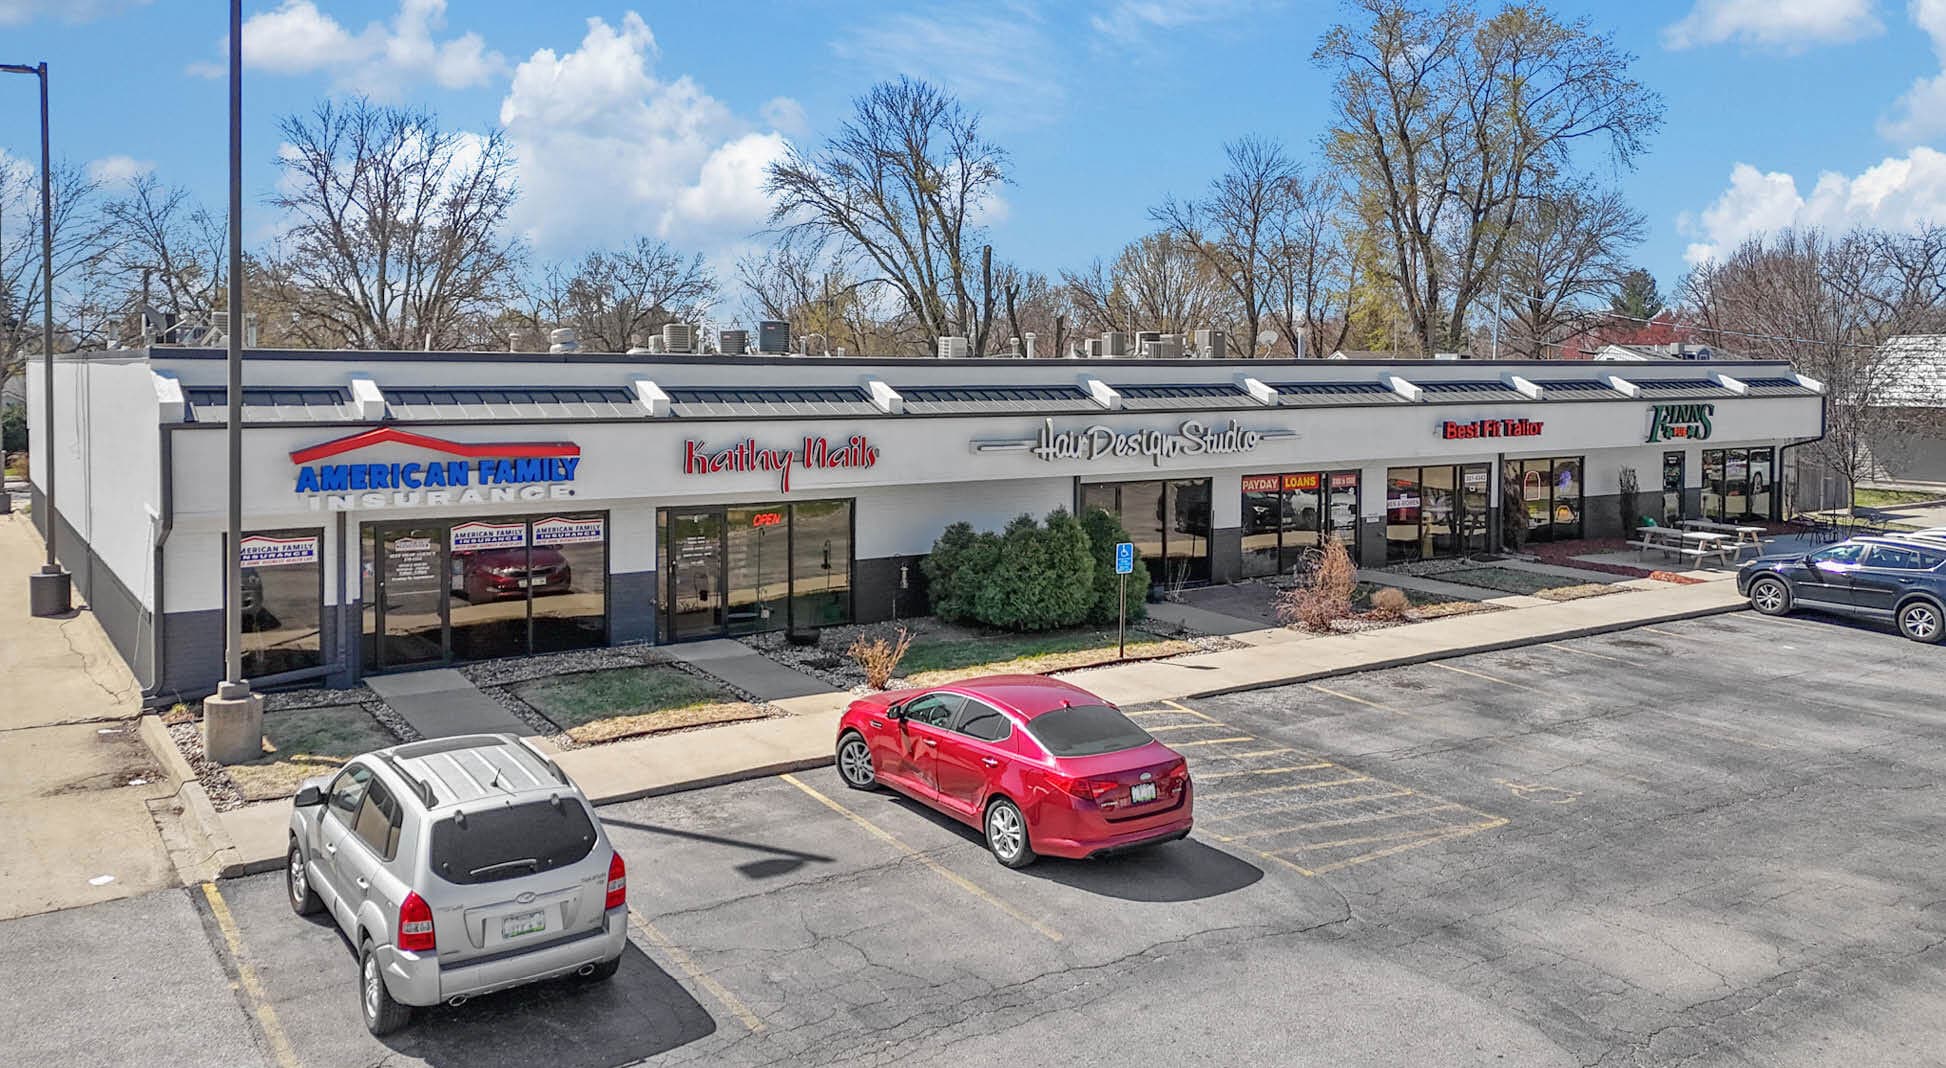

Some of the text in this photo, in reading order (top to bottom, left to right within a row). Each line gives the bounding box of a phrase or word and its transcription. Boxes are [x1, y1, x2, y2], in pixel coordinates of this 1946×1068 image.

[1444, 418, 1544, 439] Best Fit Tailor
[1032, 417, 1258, 466] Hair Design Studio
[685, 435, 878, 493] Kathy Nails
[296, 457, 580, 493] AMERICAN FAMILY
[1242, 476, 1317, 490] PAYDAY LOANS
[307, 483, 569, 512] INSURANCE
[752, 513, 782, 527] OPEN
[454, 530, 494, 538] AMERICAN
[459, 535, 518, 543] INSURANCE
[240, 543, 314, 554] MERICAN FAMILY
[242, 550, 308, 560] NSURANCE
